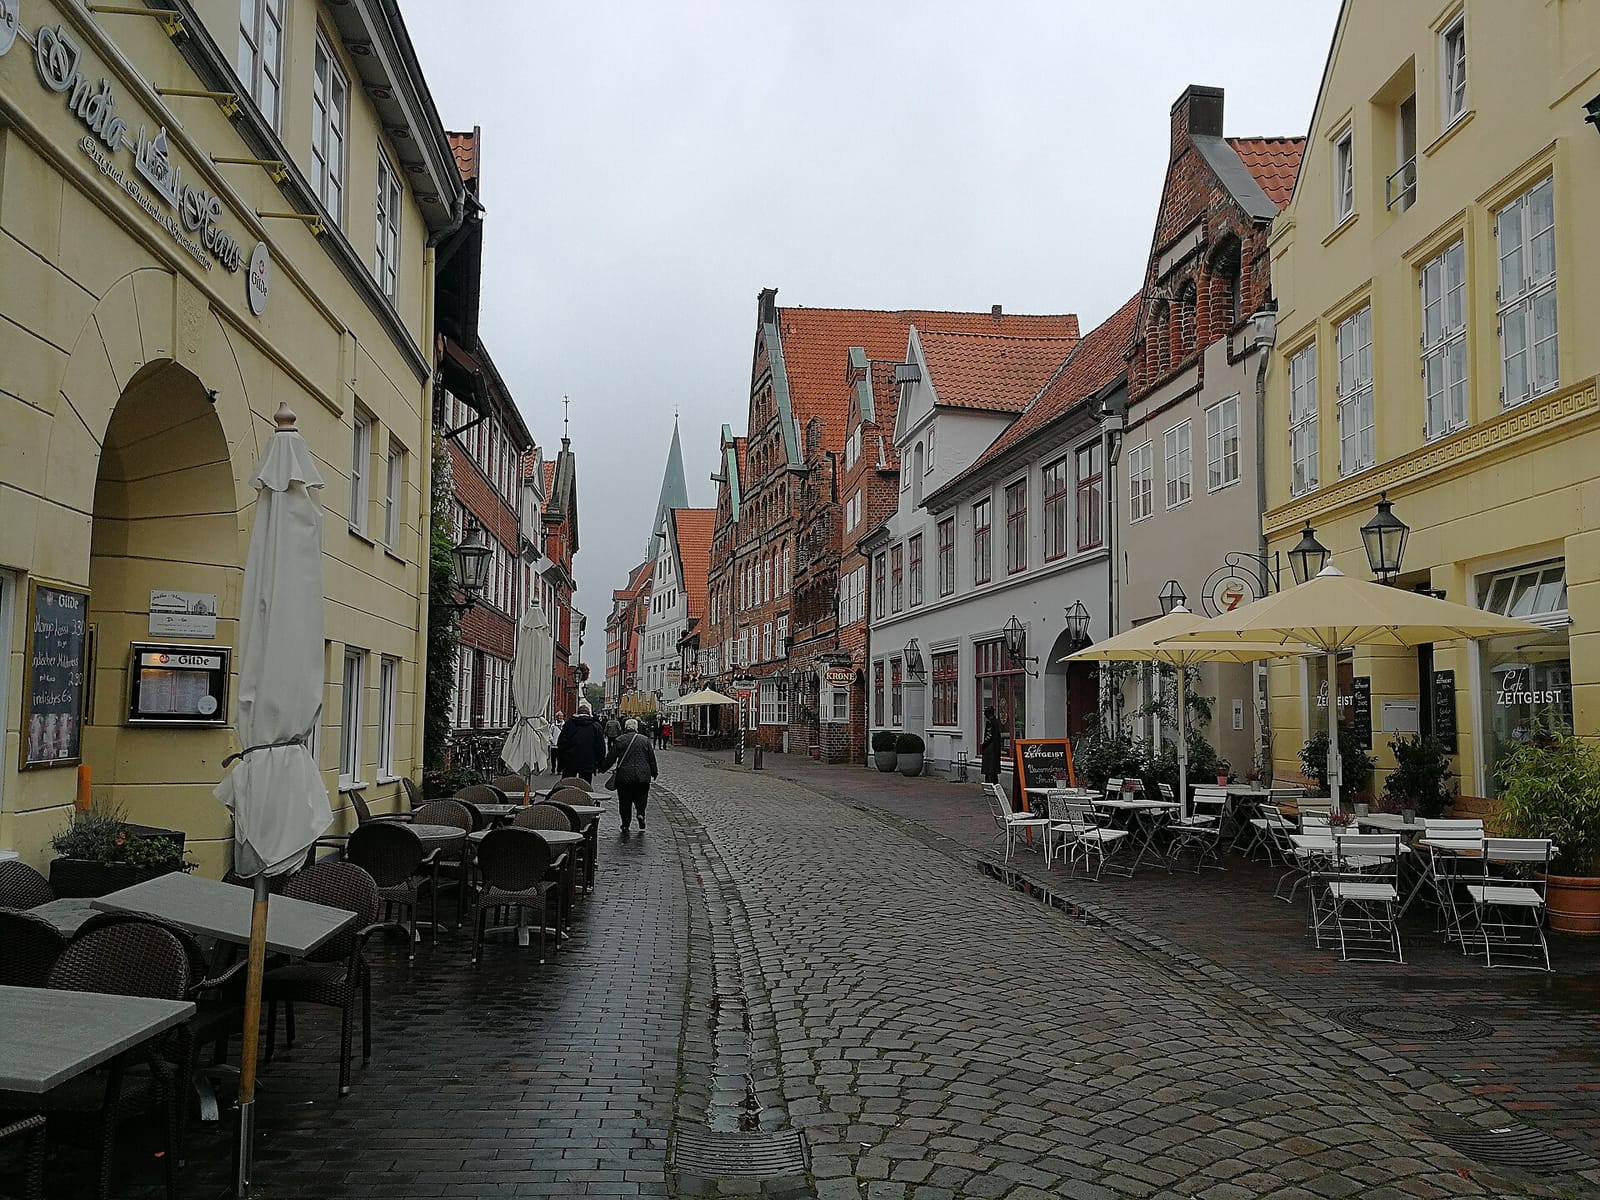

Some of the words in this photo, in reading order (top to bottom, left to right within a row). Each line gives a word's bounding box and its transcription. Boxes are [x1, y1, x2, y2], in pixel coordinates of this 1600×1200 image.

[36, 25, 127, 153] India
[179, 183, 243, 273] Haus
[251, 271, 268, 297] Gilde
[58, 594, 79, 610] Gilde
[34, 614, 54, 639] Mango
[178, 655, 210, 666] Gilde
[826, 672, 855, 681] KRONE
[1503, 666, 1525, 694] Café
[62, 688, 73, 703] Eis
[1316, 695, 1354, 707] ZEIEIST
[1496, 690, 1562, 705] ZEITGEIST
